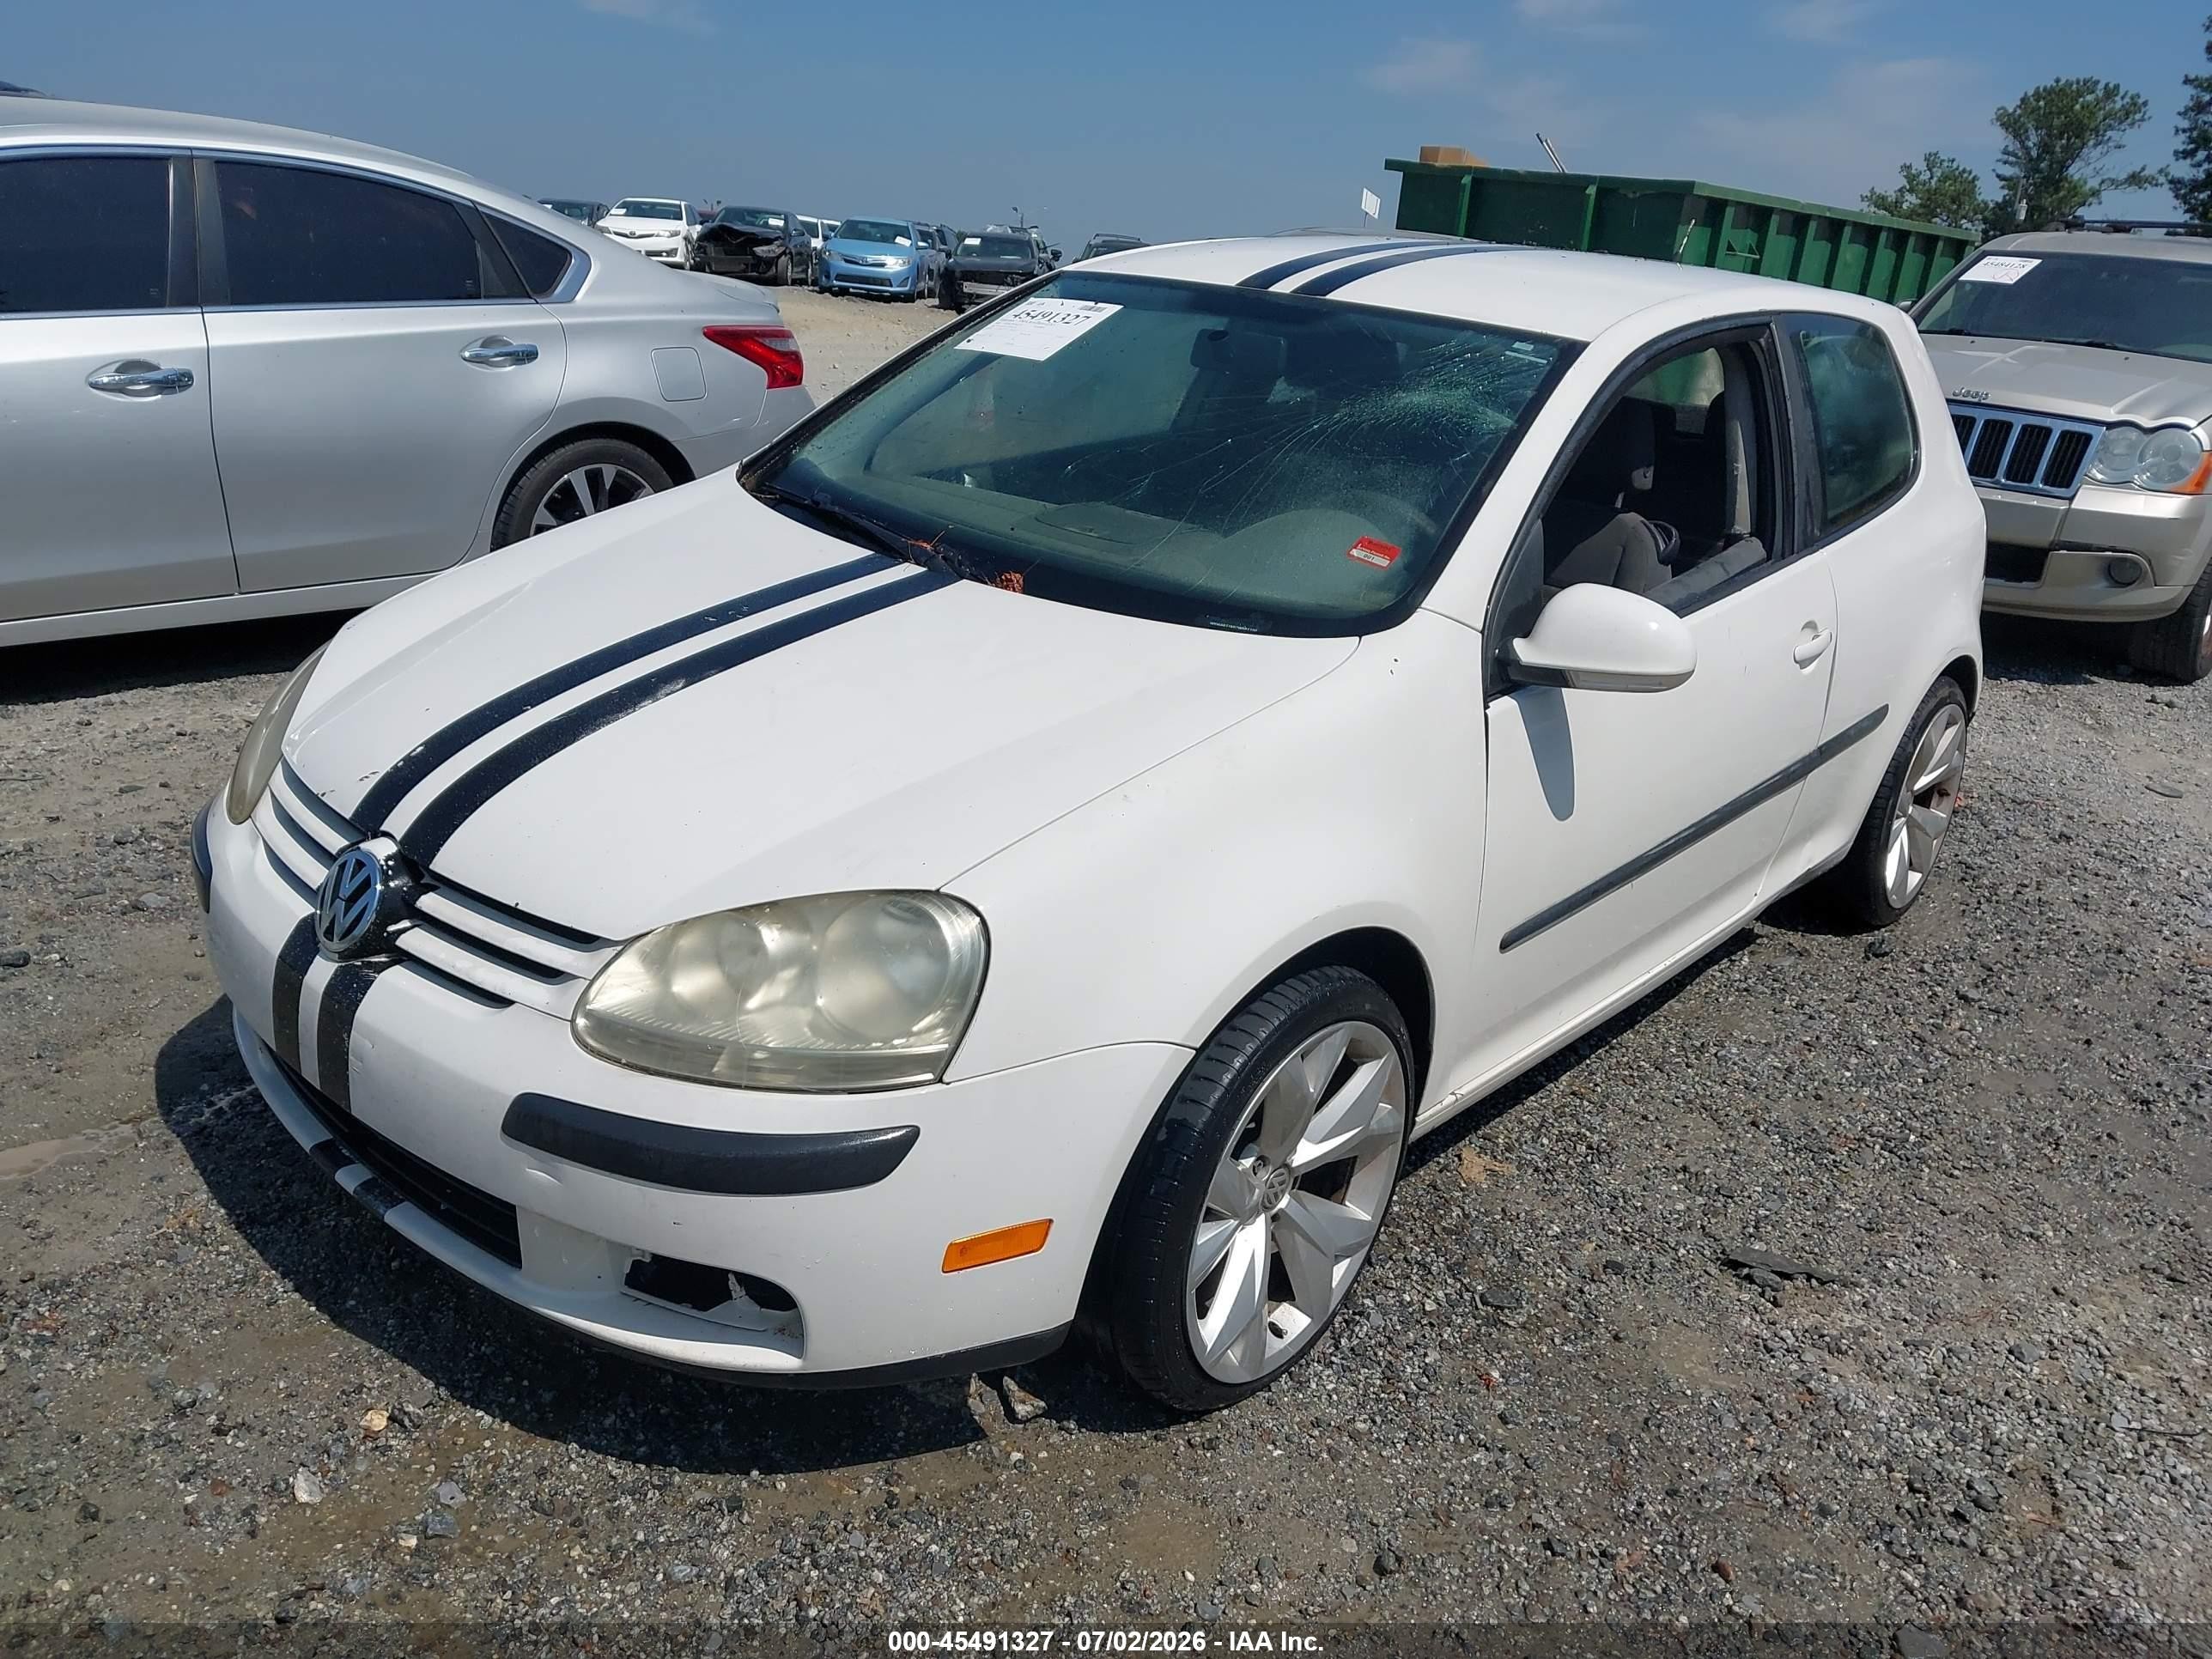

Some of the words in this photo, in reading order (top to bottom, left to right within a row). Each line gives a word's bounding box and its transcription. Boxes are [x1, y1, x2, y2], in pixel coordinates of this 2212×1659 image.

[1012, 309, 1092, 325] 45491327
[1952, 386, 1990, 403] Jeep
[316, 848, 380, 951] VW
